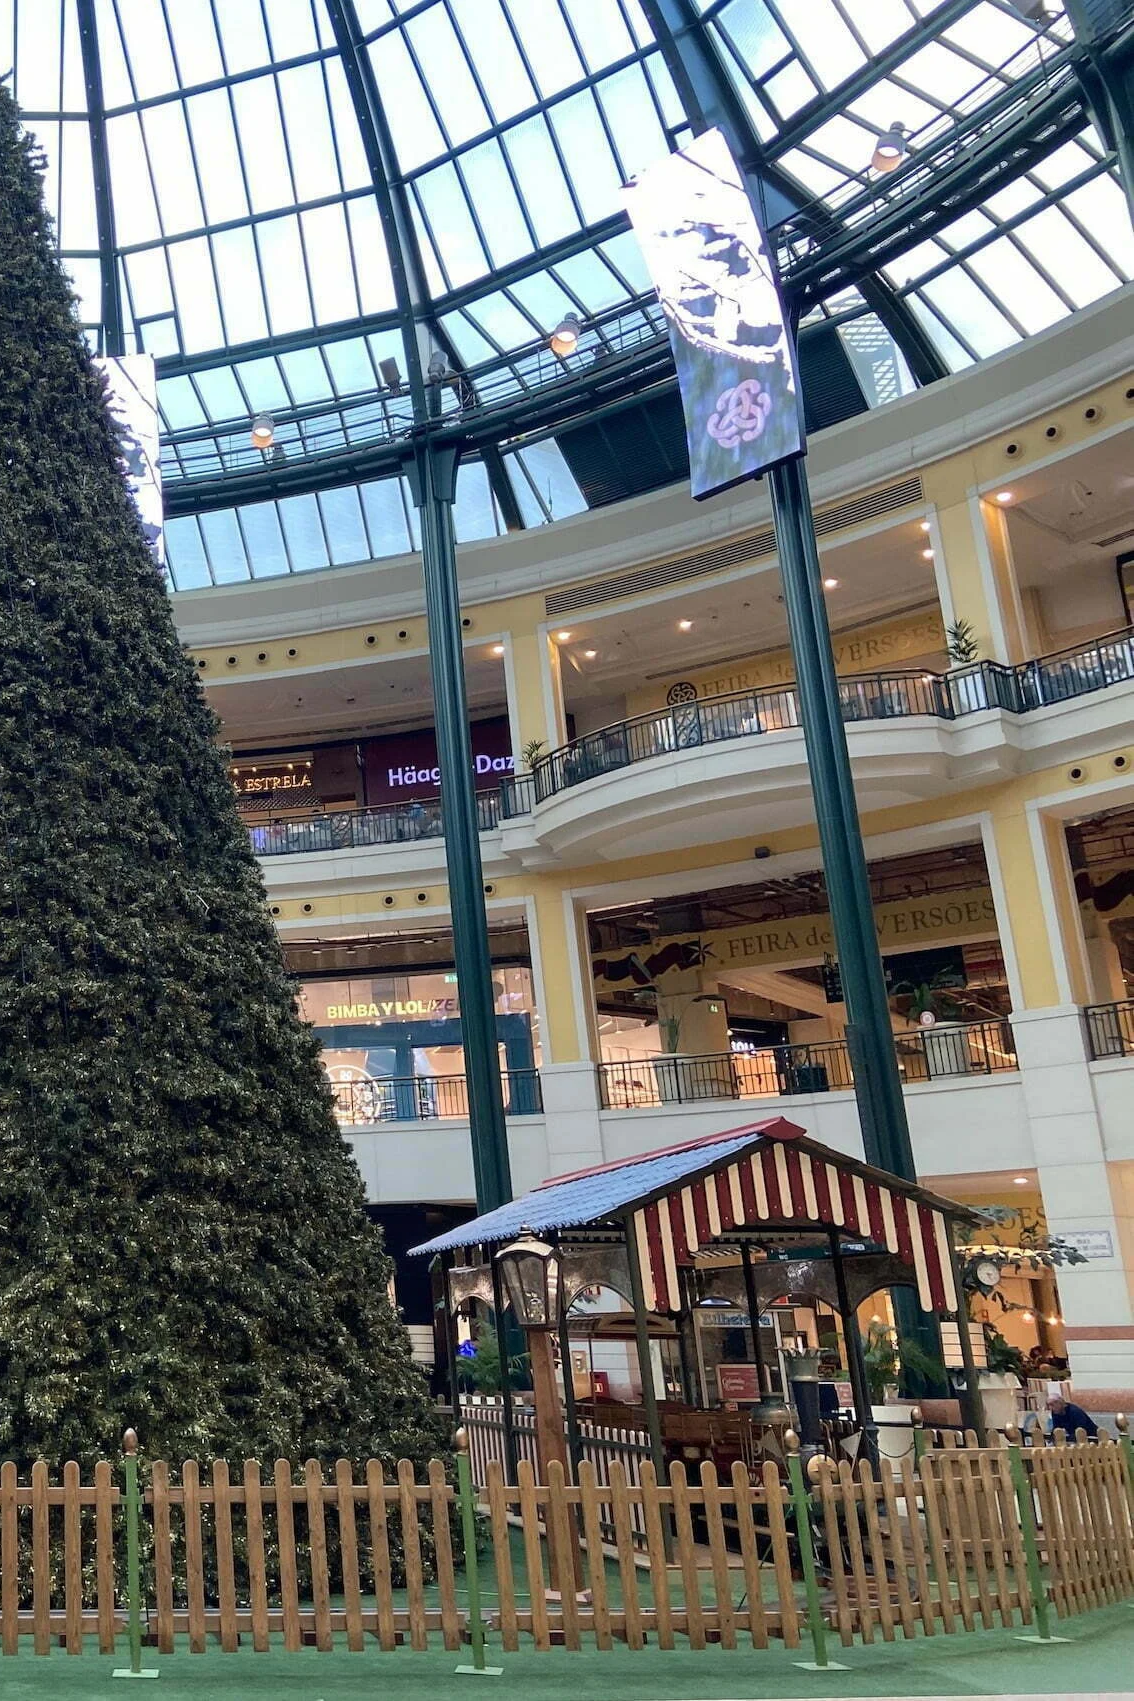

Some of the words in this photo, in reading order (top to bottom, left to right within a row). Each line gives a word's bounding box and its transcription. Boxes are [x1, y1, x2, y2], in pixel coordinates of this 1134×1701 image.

[244, 773, 312, 792] ESTRELA
[727, 931, 800, 958] FEIRA
[806, 926, 831, 947] de
[876, 899, 996, 935] VERSÕES
[327, 1003, 380, 1019] BIMBA
[381, 1002, 394, 1016] Y
